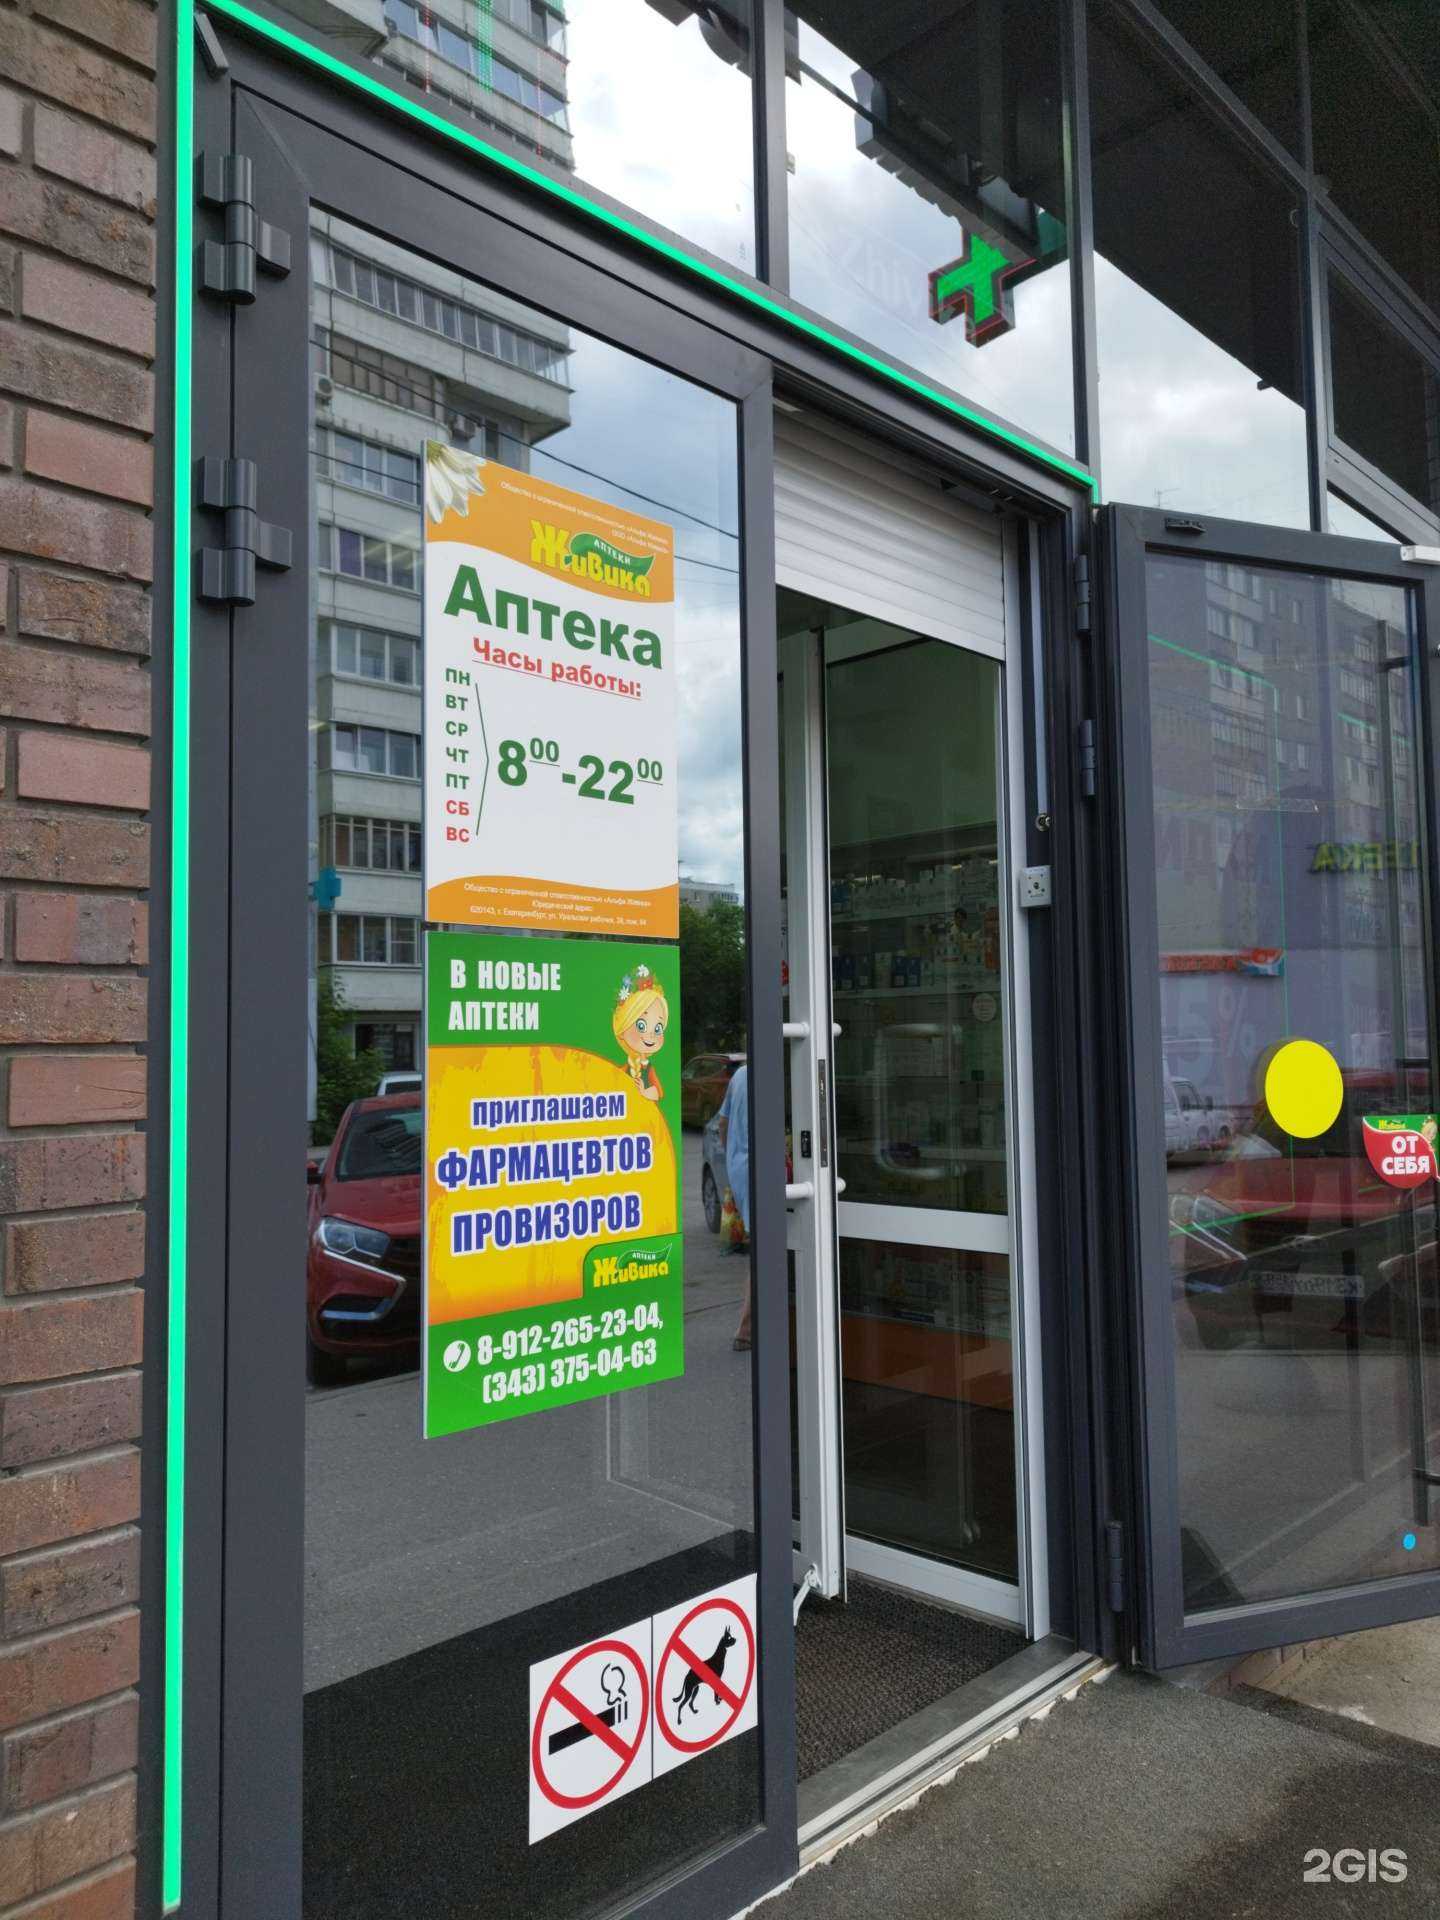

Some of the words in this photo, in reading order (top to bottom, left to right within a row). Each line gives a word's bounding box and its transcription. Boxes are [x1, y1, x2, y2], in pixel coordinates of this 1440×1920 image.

[593, 538, 632, 566] АПТЕКИ
[443, 563, 663, 669] Аптека
[445, 667, 471, 686] ПН
[472, 636, 543, 673] Часы
[551, 660, 642, 698] работы:
[445, 693, 468, 711] ВТ
[445, 720, 469, 737] СР
[445, 745, 470, 764] ЧТ
[445, 772, 470, 789] ПТ
[445, 799, 470, 816] СБ
[445, 826, 470, 843] ВС
[450, 960, 466, 989] В
[478, 961, 561, 991] НОВЫЕ
[448, 1001, 539, 1030] АПТЕКИ
[473, 1094, 625, 1128] приглашаем
[1392, 1136, 1419, 1154] ОТ
[437, 1136, 652, 1188] ФАРМАЦЕВТОВ
[1382, 1156, 1430, 1176] СЕБЯ
[453, 1194, 641, 1253] ПРОВИЗОРОВ
[477, 1302, 664, 1366] 8-912-265-23-04,
[483, 1362, 545, 1404] (343)
[551, 1338, 657, 1388] 375-04-63
